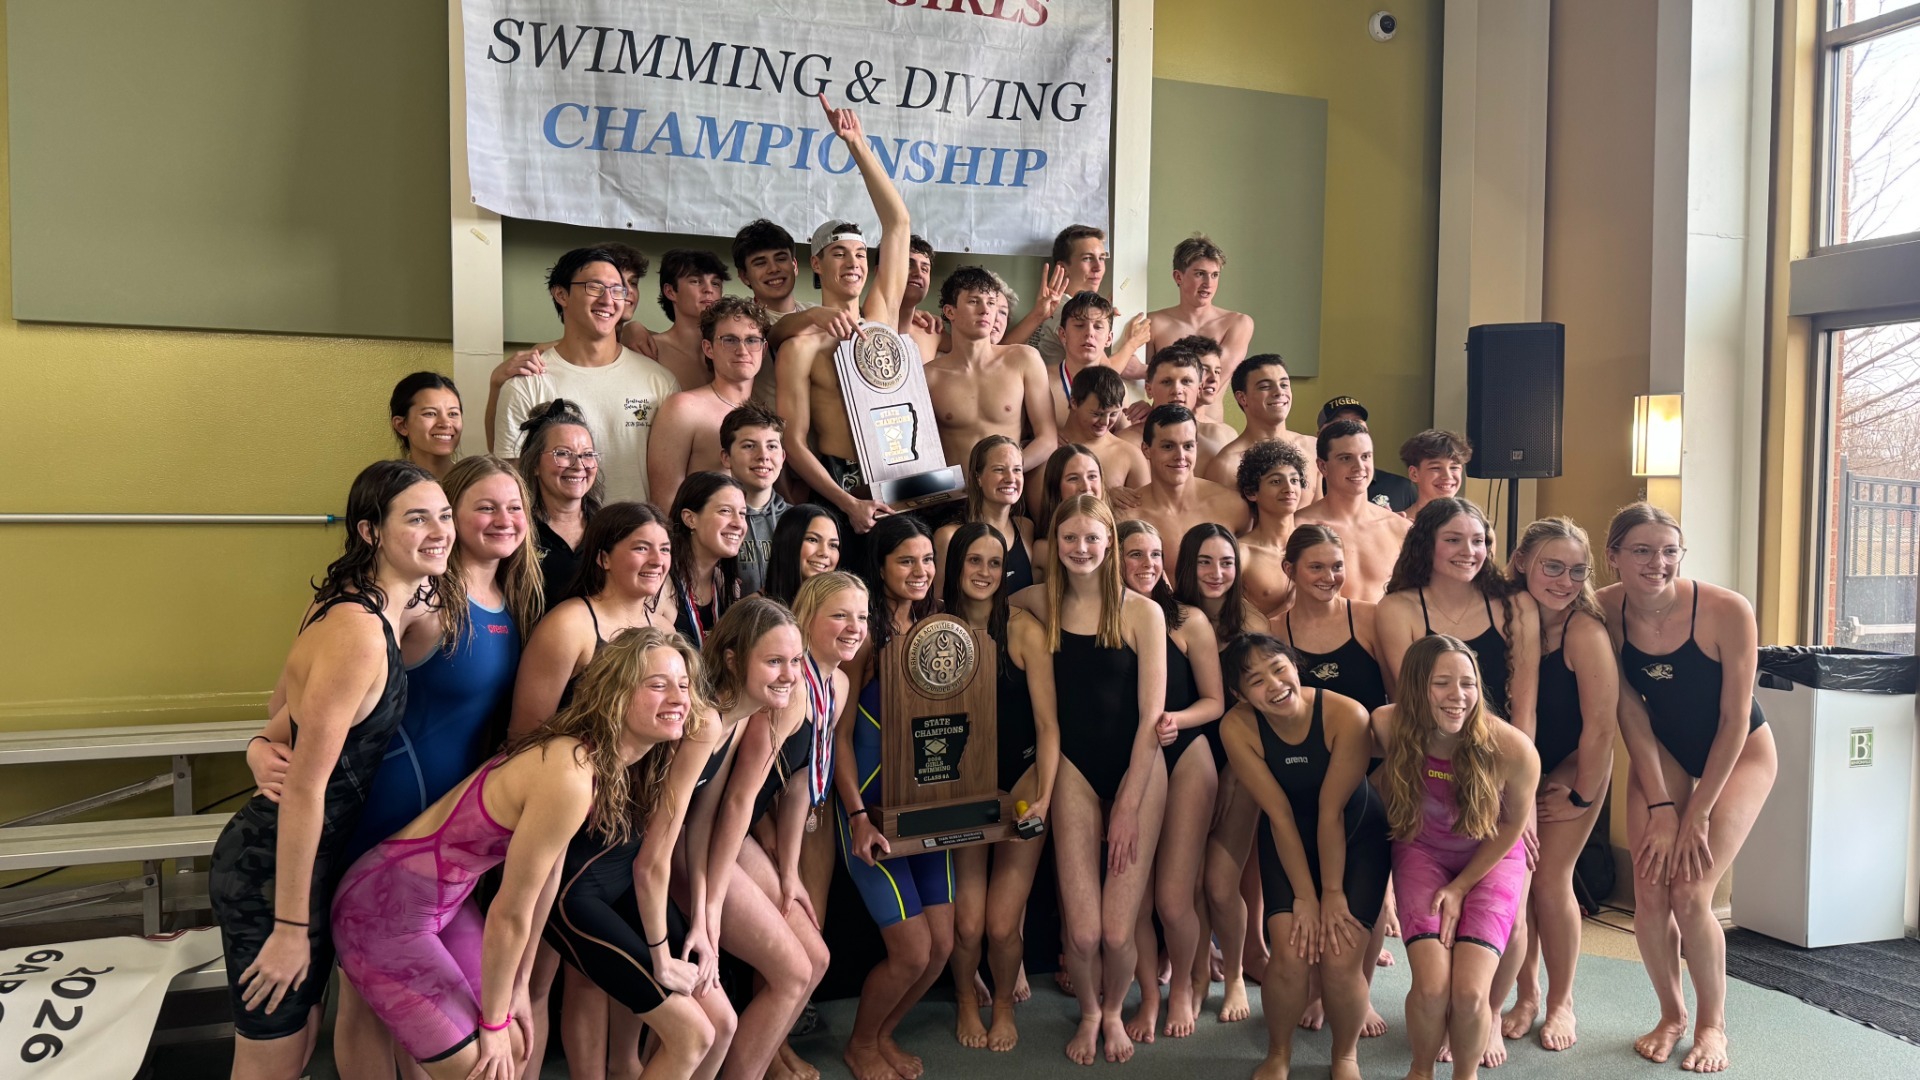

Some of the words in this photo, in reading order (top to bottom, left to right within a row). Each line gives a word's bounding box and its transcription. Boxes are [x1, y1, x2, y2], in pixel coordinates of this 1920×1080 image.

[487, 17, 832, 98] SWIMMING
[845, 60, 886, 105] &
[896, 66, 1088, 122] DIVING
[542, 102, 1049, 188] CHAMPIONSHIP
[914, 725, 964, 738] CHAMPIONS
[924, 718, 951, 728] STATE
[1285, 756, 1309, 765] arena
[20, 966, 115, 1063] 2026
